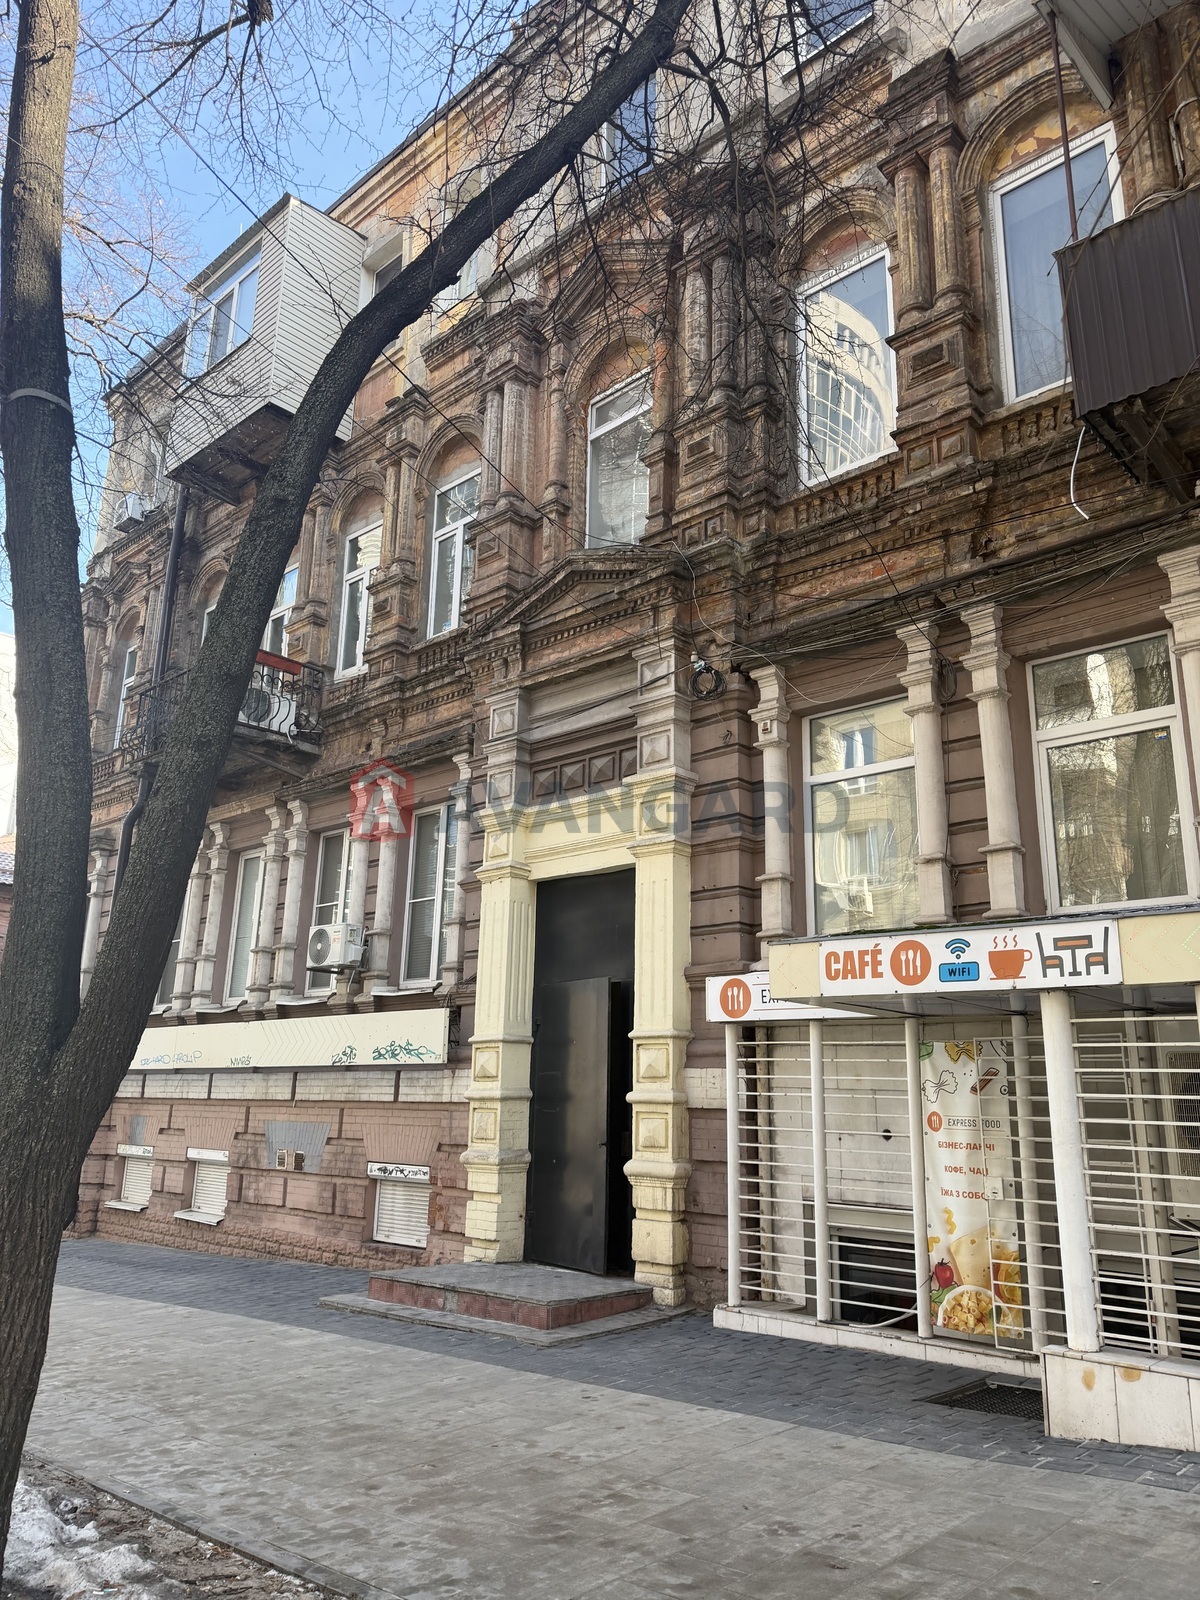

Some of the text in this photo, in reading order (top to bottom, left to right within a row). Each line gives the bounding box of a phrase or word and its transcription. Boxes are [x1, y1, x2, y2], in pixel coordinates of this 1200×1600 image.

[825, 943, 884, 981] CAFÉ
[948, 967, 971, 977] WIFI
[947, 1118, 977, 1128] EXPRESS
[944, 1165, 967, 1176] КОФЕ,
[940, 1187, 954, 1197] ЇЖА
